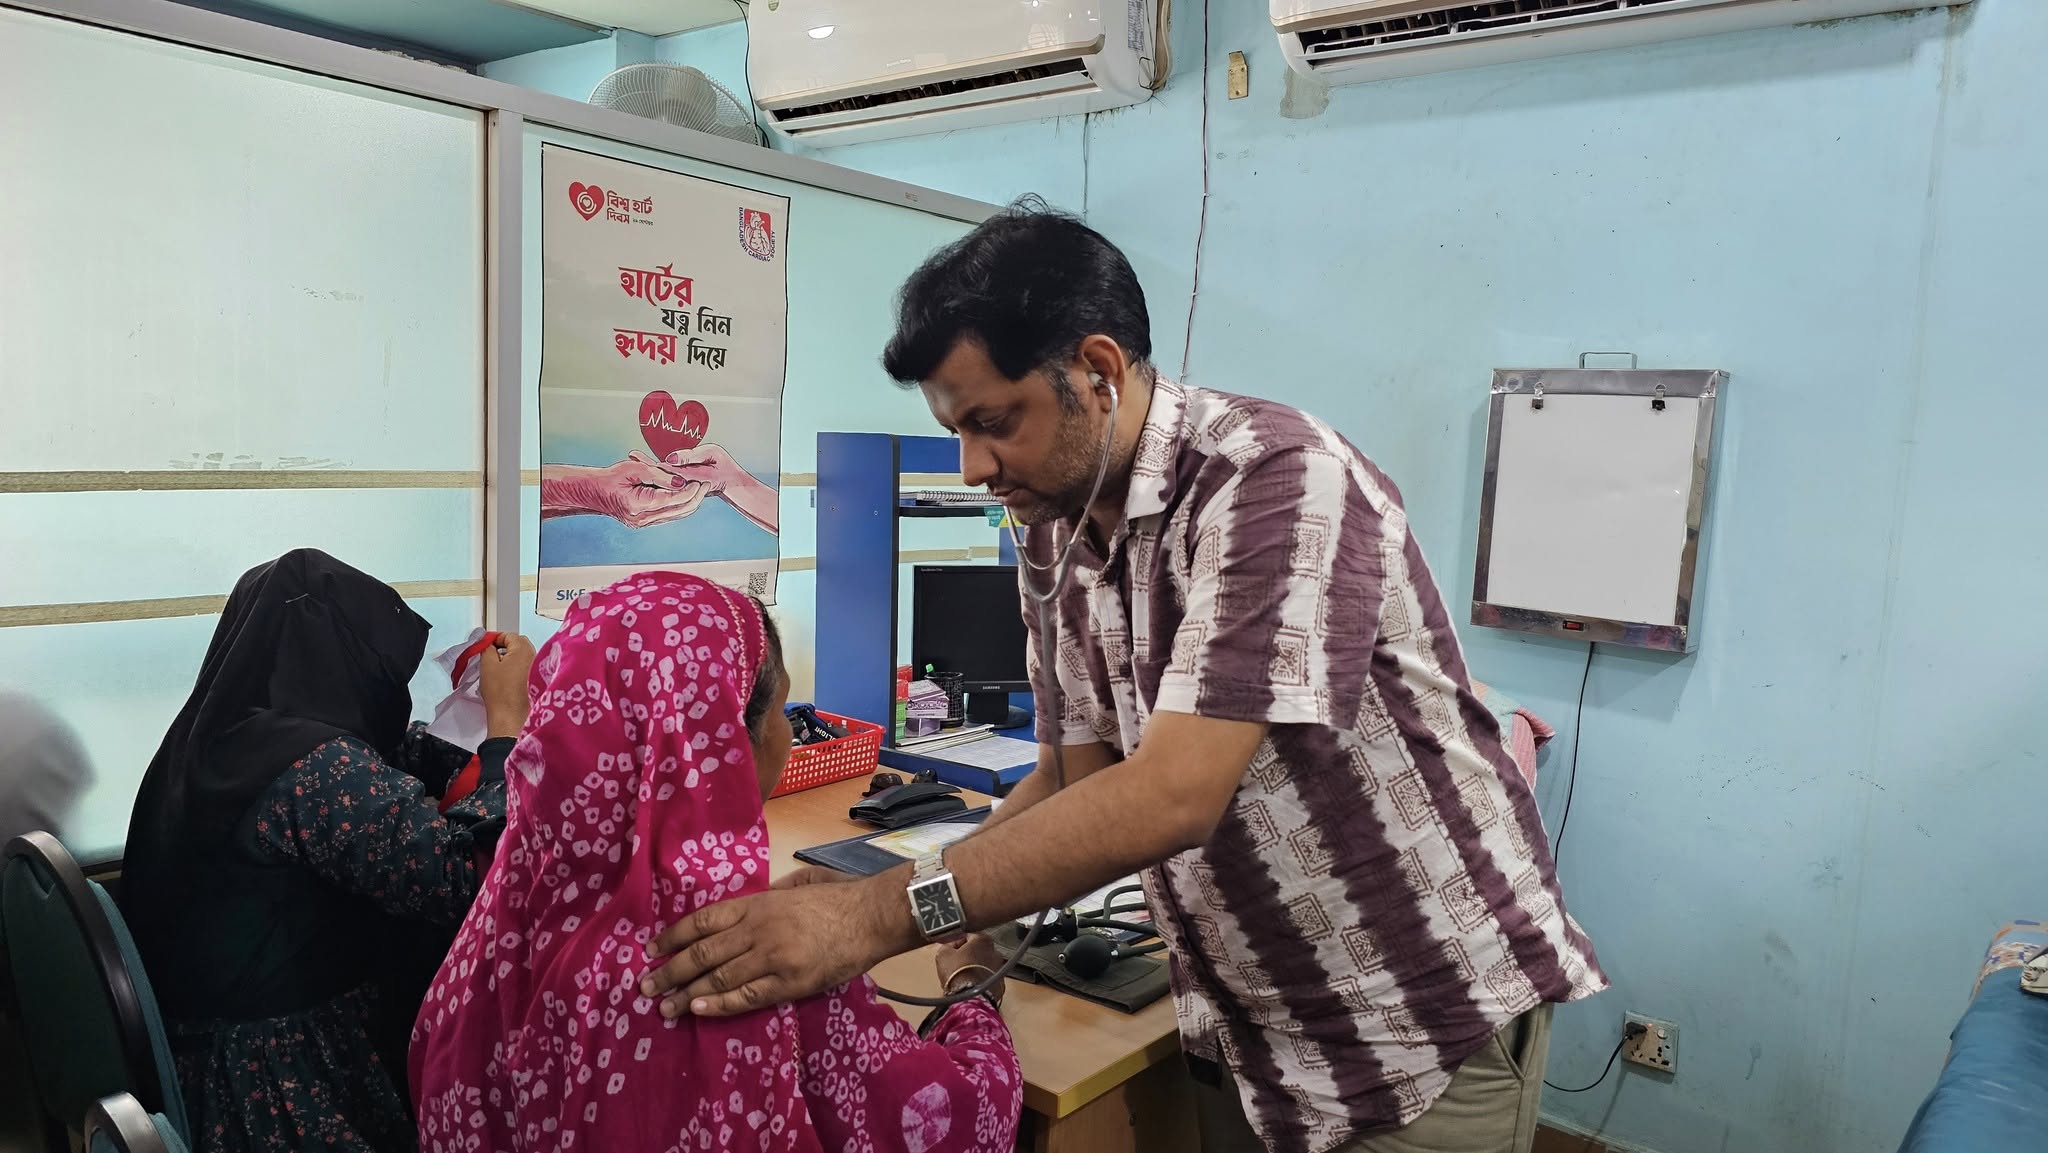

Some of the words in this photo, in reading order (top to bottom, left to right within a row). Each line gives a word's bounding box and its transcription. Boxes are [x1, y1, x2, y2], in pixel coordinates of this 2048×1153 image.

[607, 190, 630, 212] বিশ্ব
[632, 196, 653, 214] হার্ট
[607, 207, 630, 225] দিবস
[738, 206, 749, 252] BANGLADESH
[618, 263, 694, 308] হার্টের
[660, 308, 691, 336] যত্ন
[696, 306, 732, 336] নিন
[613, 328, 678, 365] হৃদয়
[687, 337, 728, 371] দিয়ে
